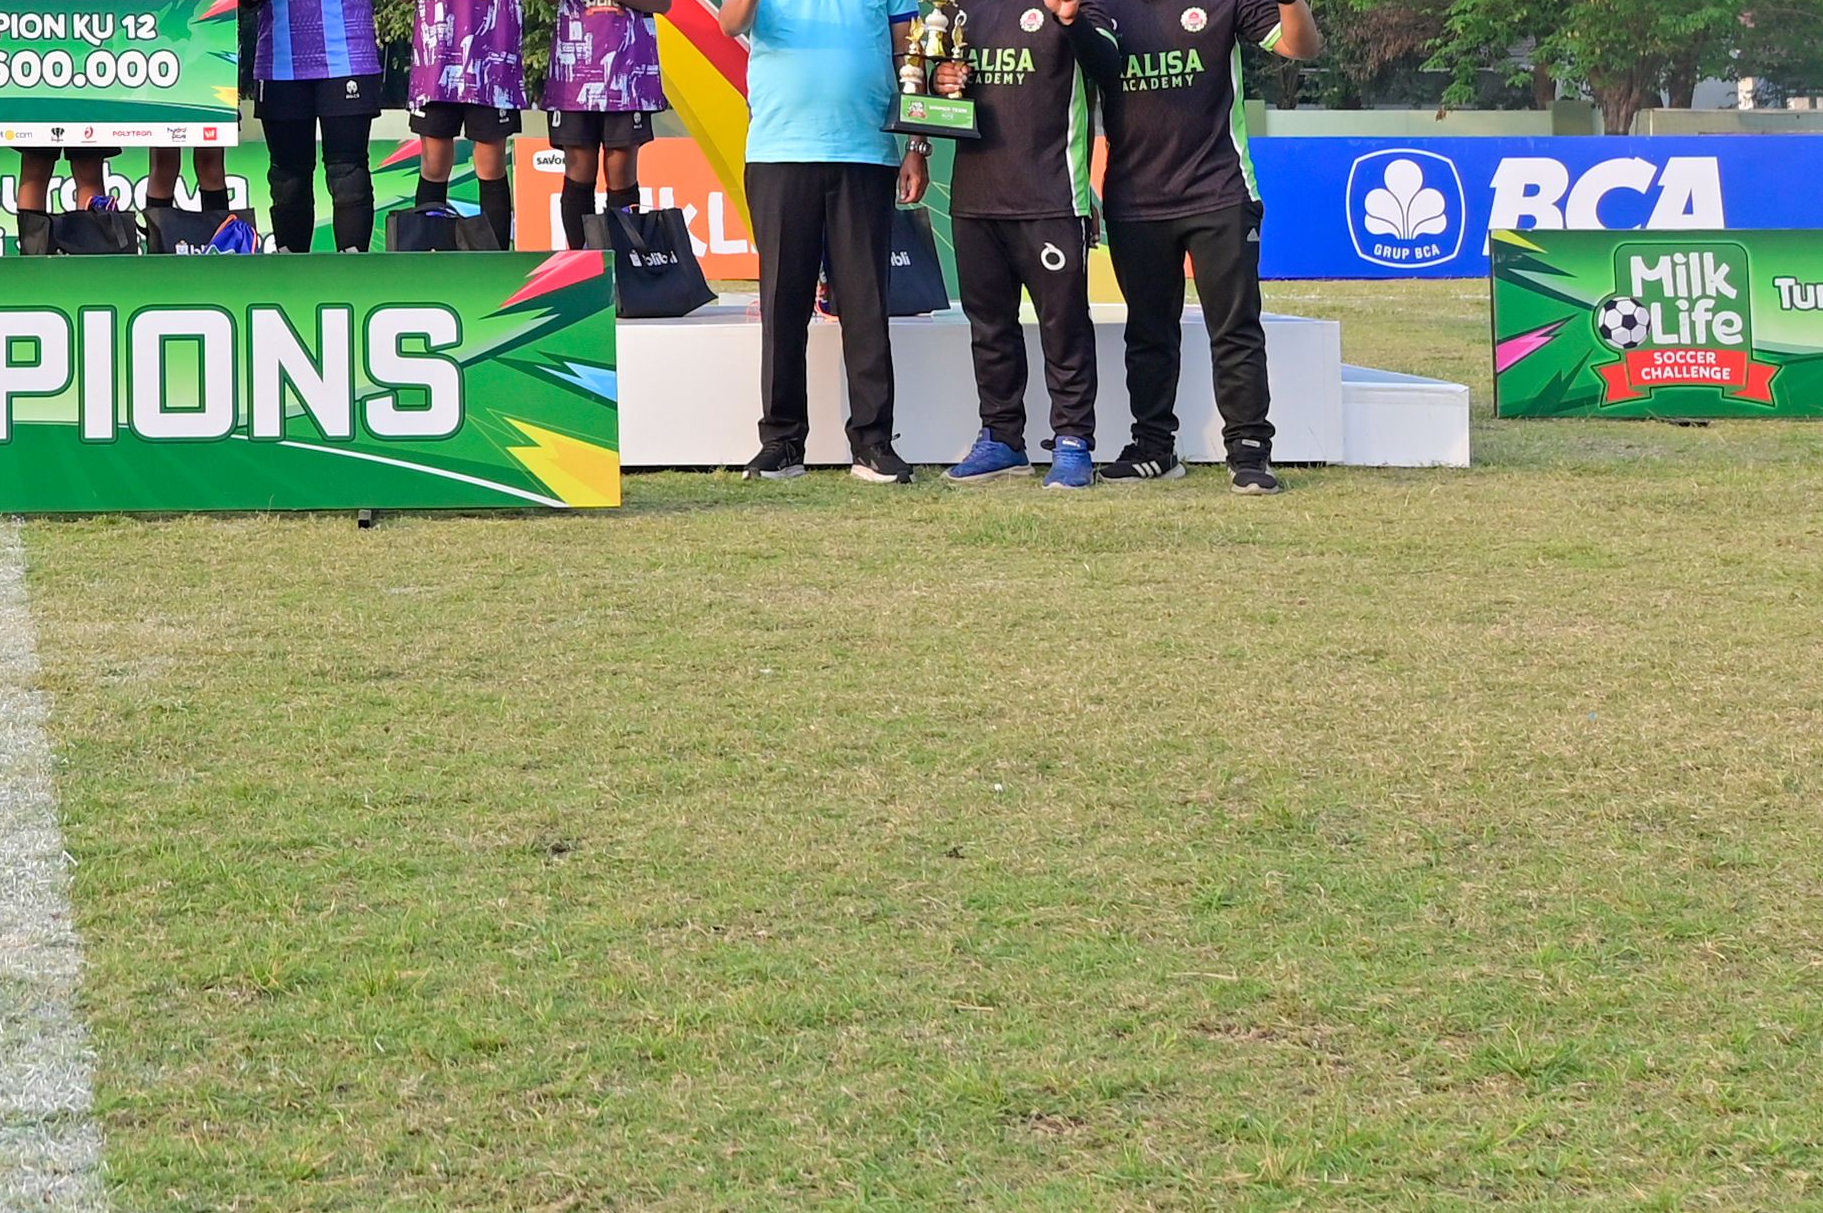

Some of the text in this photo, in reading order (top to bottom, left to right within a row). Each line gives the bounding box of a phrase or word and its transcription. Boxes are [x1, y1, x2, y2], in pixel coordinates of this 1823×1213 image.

[74, 13, 114, 46] KU
[121, 13, 157, 40] 12
[1482, 156, 1726, 255] BCA
[1373, 243, 1441, 260] GRUP BCA
[1629, 251, 1738, 300] Milk
[1649, 298, 1744, 346] Life
[1640, 367, 1731, 381] CHALLENGE
[1652, 350, 1717, 366] SOCCER
